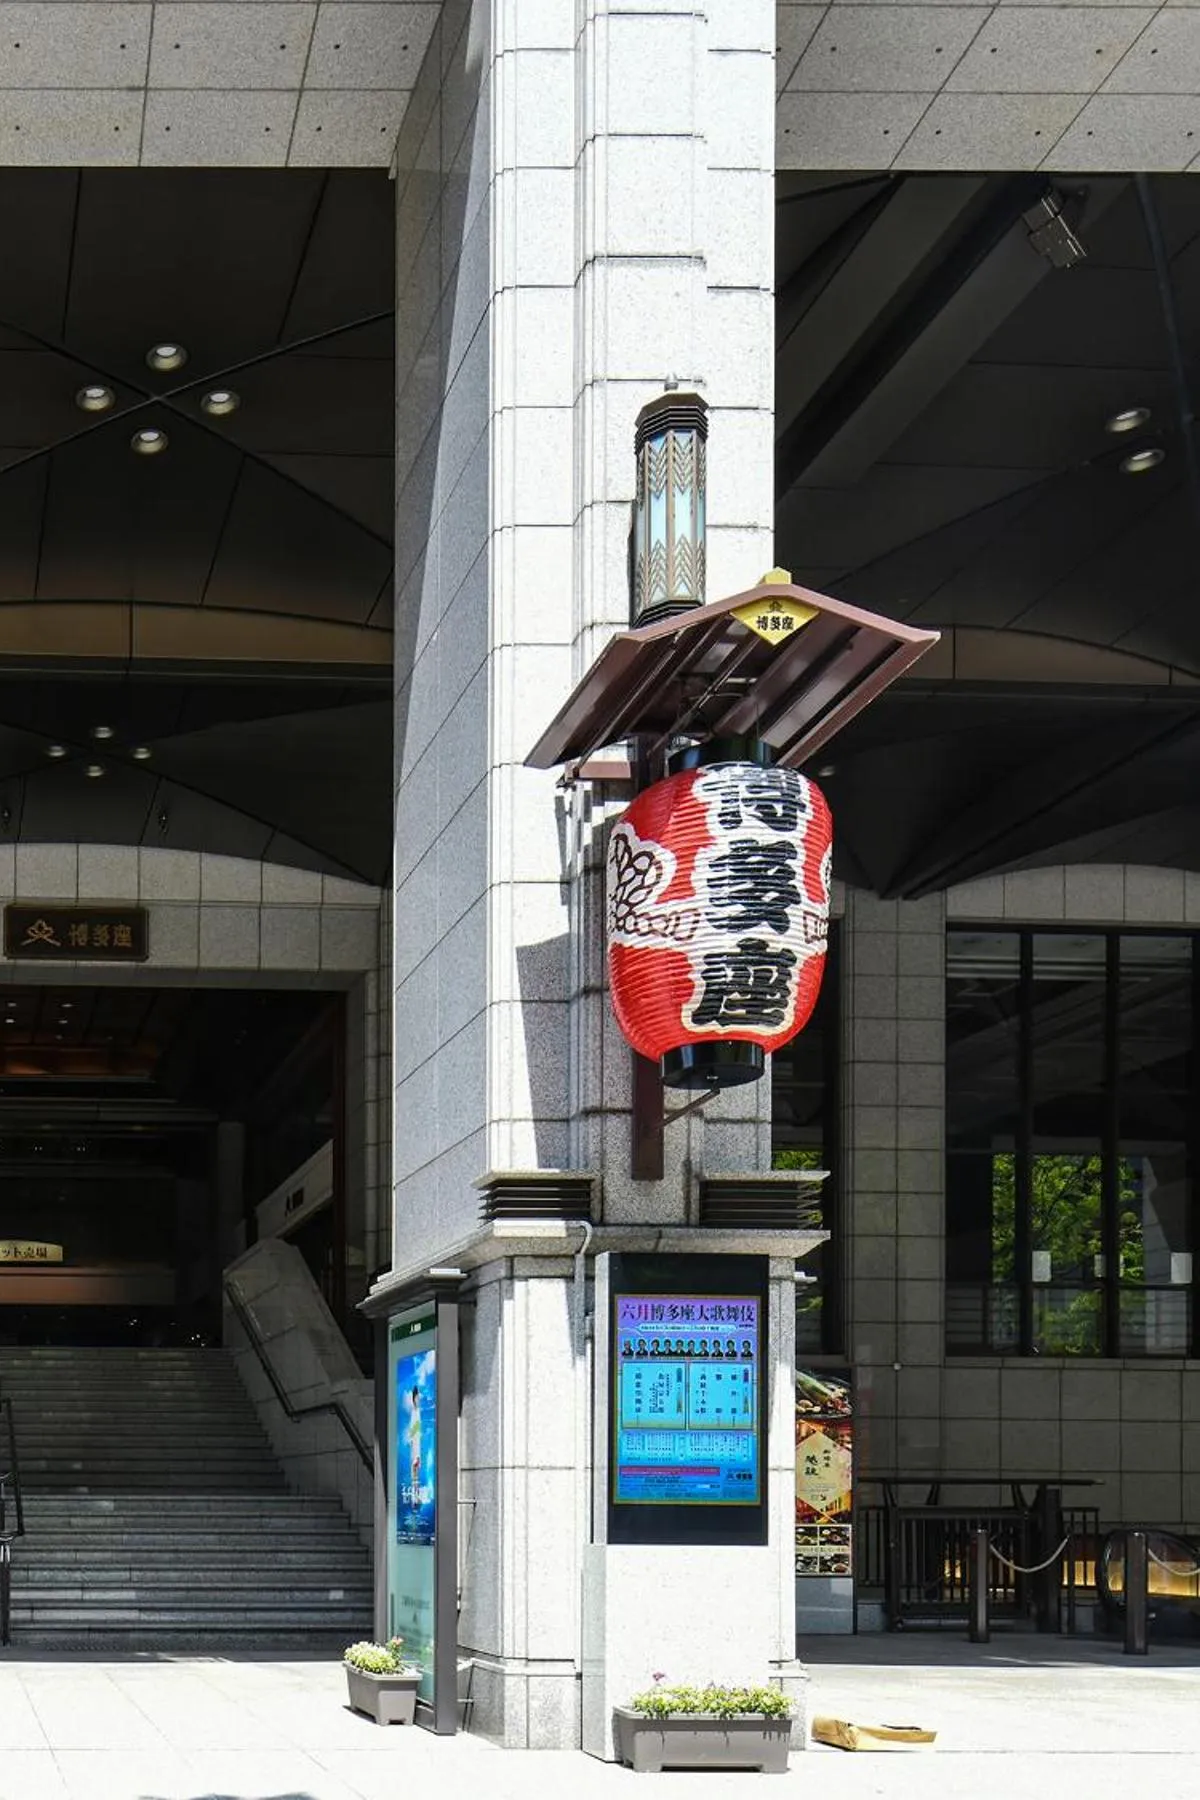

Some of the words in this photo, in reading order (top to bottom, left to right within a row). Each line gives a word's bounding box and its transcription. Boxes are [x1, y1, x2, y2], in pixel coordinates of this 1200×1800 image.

[755, 614, 795, 633] 博多座
[690, 762, 807, 1027] 博多座
[67, 922, 133, 947] 博多座
[621, 1304, 755, 1323] 六月博多座大歌舞伎
